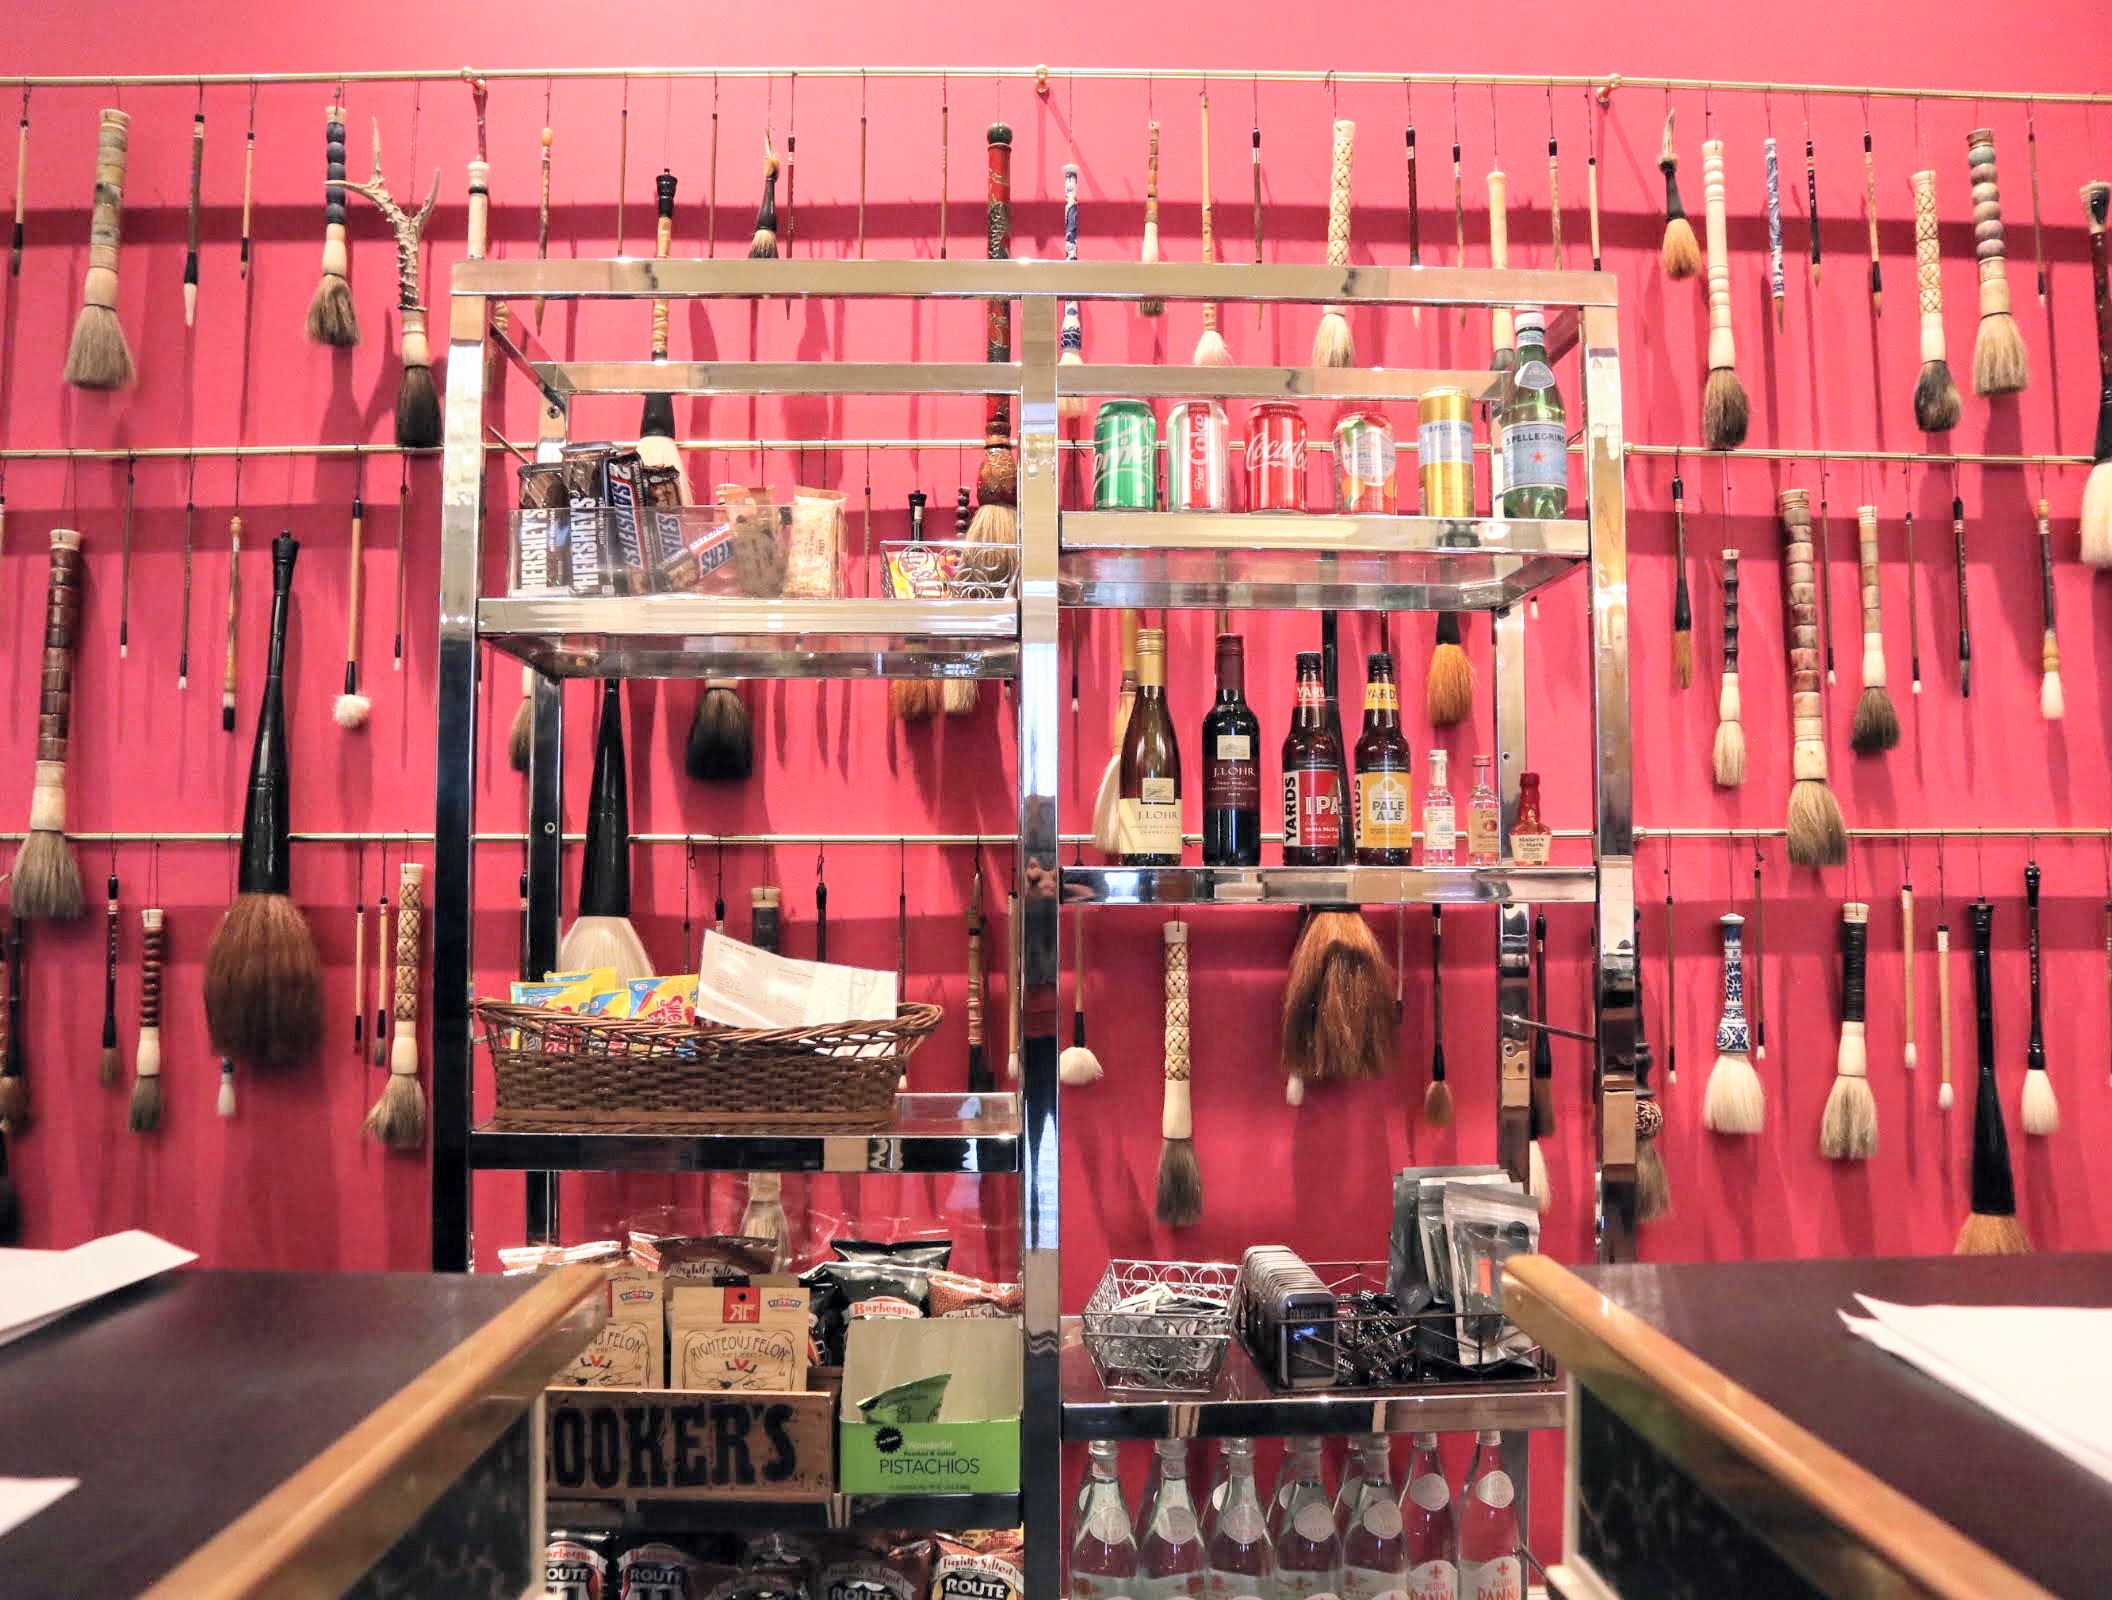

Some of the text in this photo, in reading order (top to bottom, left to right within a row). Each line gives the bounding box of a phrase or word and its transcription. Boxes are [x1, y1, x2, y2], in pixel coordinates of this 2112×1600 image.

[1189, 414, 1210, 466] Coke
[1094, 434, 1150, 476] prite
[1194, 466, 1205, 489] Diet
[611, 482, 642, 567] SATISFIES
[521, 509, 548, 589] HERSHEY'S
[570, 497, 599, 588] HERSHEY'S
[1285, 776, 1297, 842] YARDS
[1304, 796, 1340, 815] IPA
[1372, 800, 1405, 811] PALE
[1376, 811, 1402, 821] ALE
[854, 1301, 915, 1316] Barbeque
[607, 1331, 643, 1353] FELON
[689, 1336, 788, 1361] RIGHTEOUS FELON
[546, 1402, 797, 1489] OOKER'S
[907, 1440, 953, 1450] Wonderful
[879, 1458, 980, 1475] PISTACHIOS
[546, 1567, 589, 1581] OUTE
[945, 1577, 1006, 1598] ROUTE
